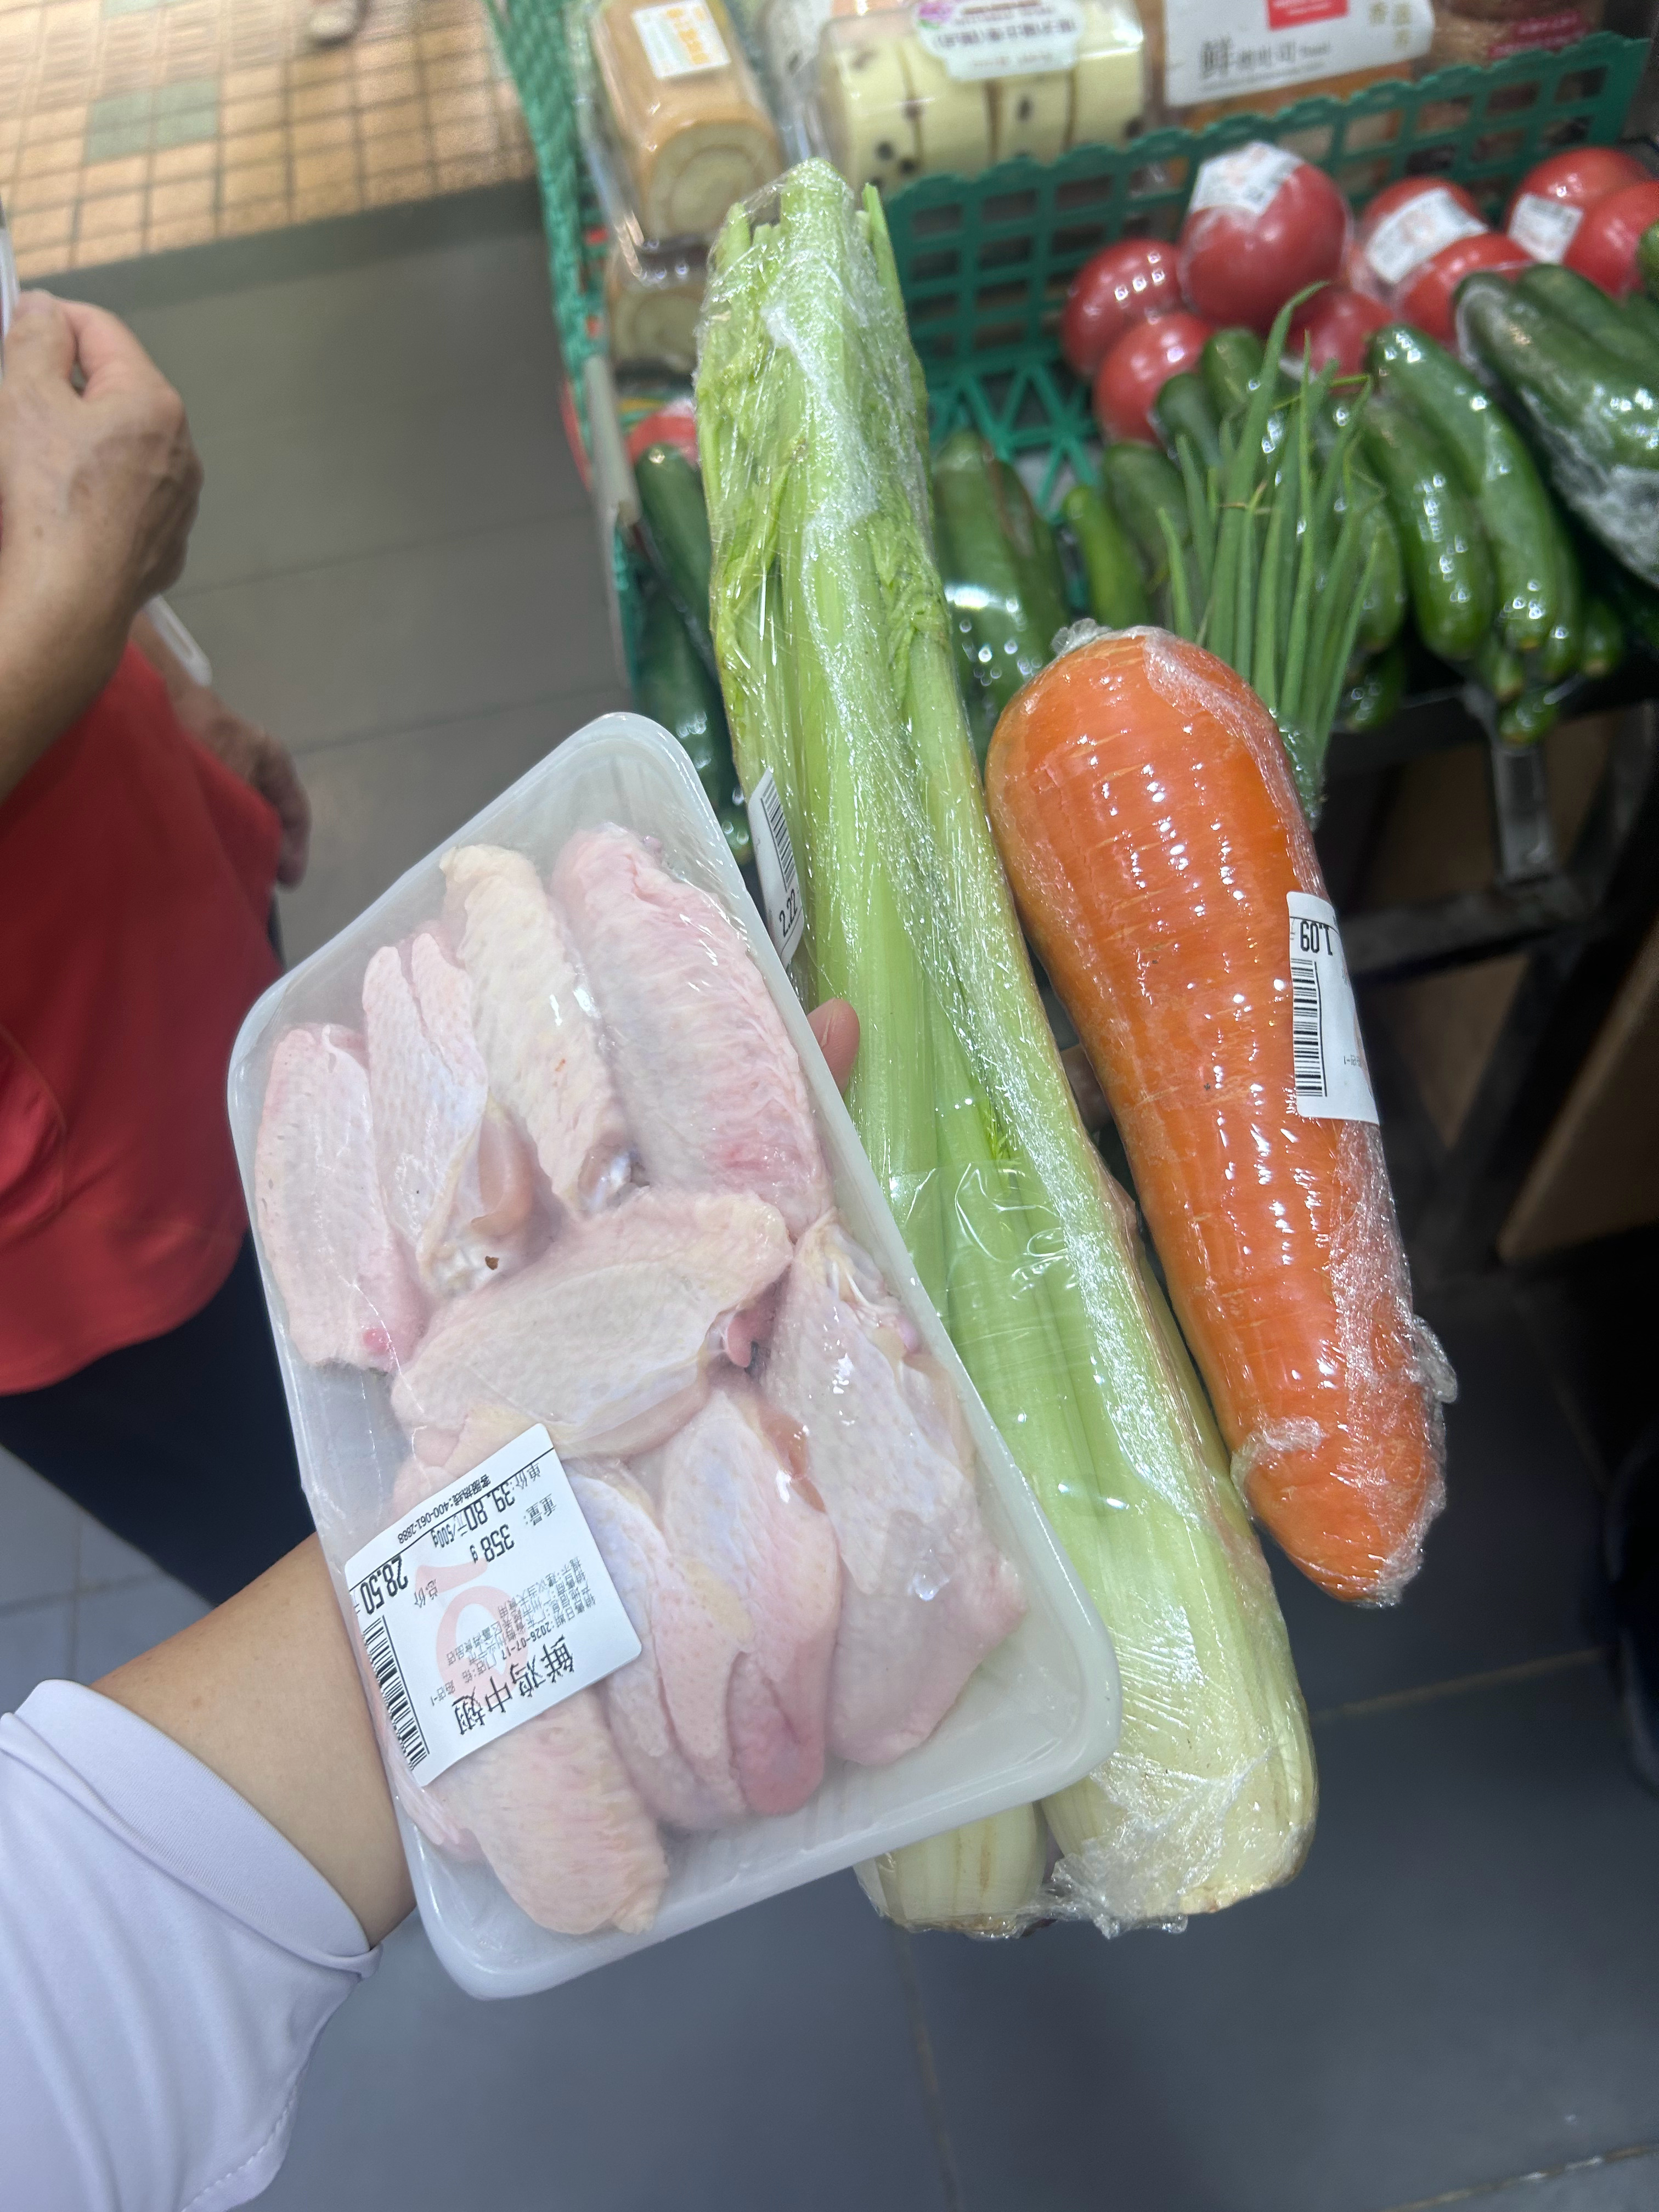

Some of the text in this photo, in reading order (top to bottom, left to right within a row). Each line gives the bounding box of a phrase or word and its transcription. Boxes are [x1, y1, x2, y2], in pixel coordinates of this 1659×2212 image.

[414, 1578, 438, 1609] 总价
[451, 1634, 575, 1736] 鲜鸡中翅
